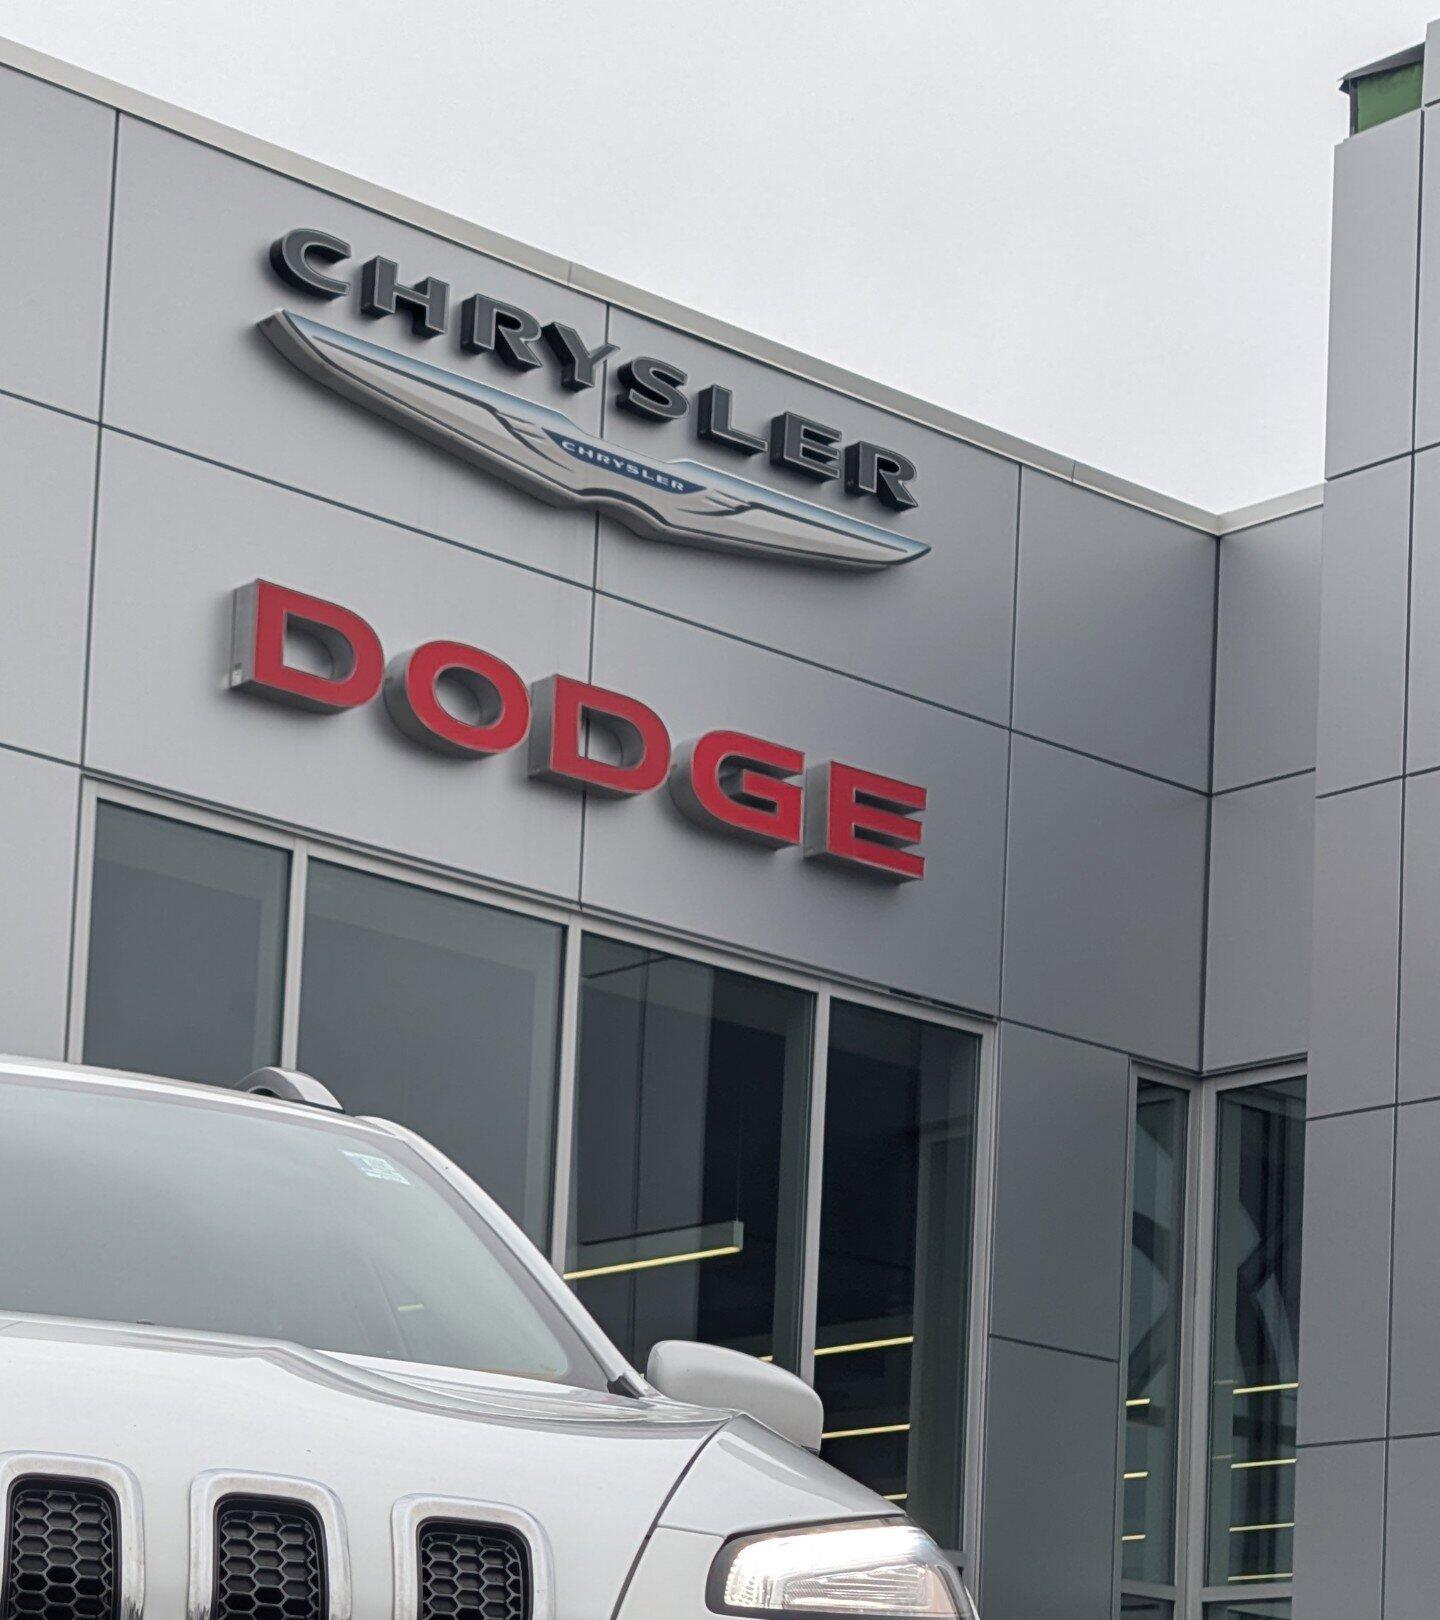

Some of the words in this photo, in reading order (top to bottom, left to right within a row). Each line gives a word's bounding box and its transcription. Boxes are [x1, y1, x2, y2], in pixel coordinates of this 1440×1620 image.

[270, 228, 919, 511] CHRYSLER
[561, 440, 685, 491] CHRYSLER
[230, 578, 927, 881] DODGE
